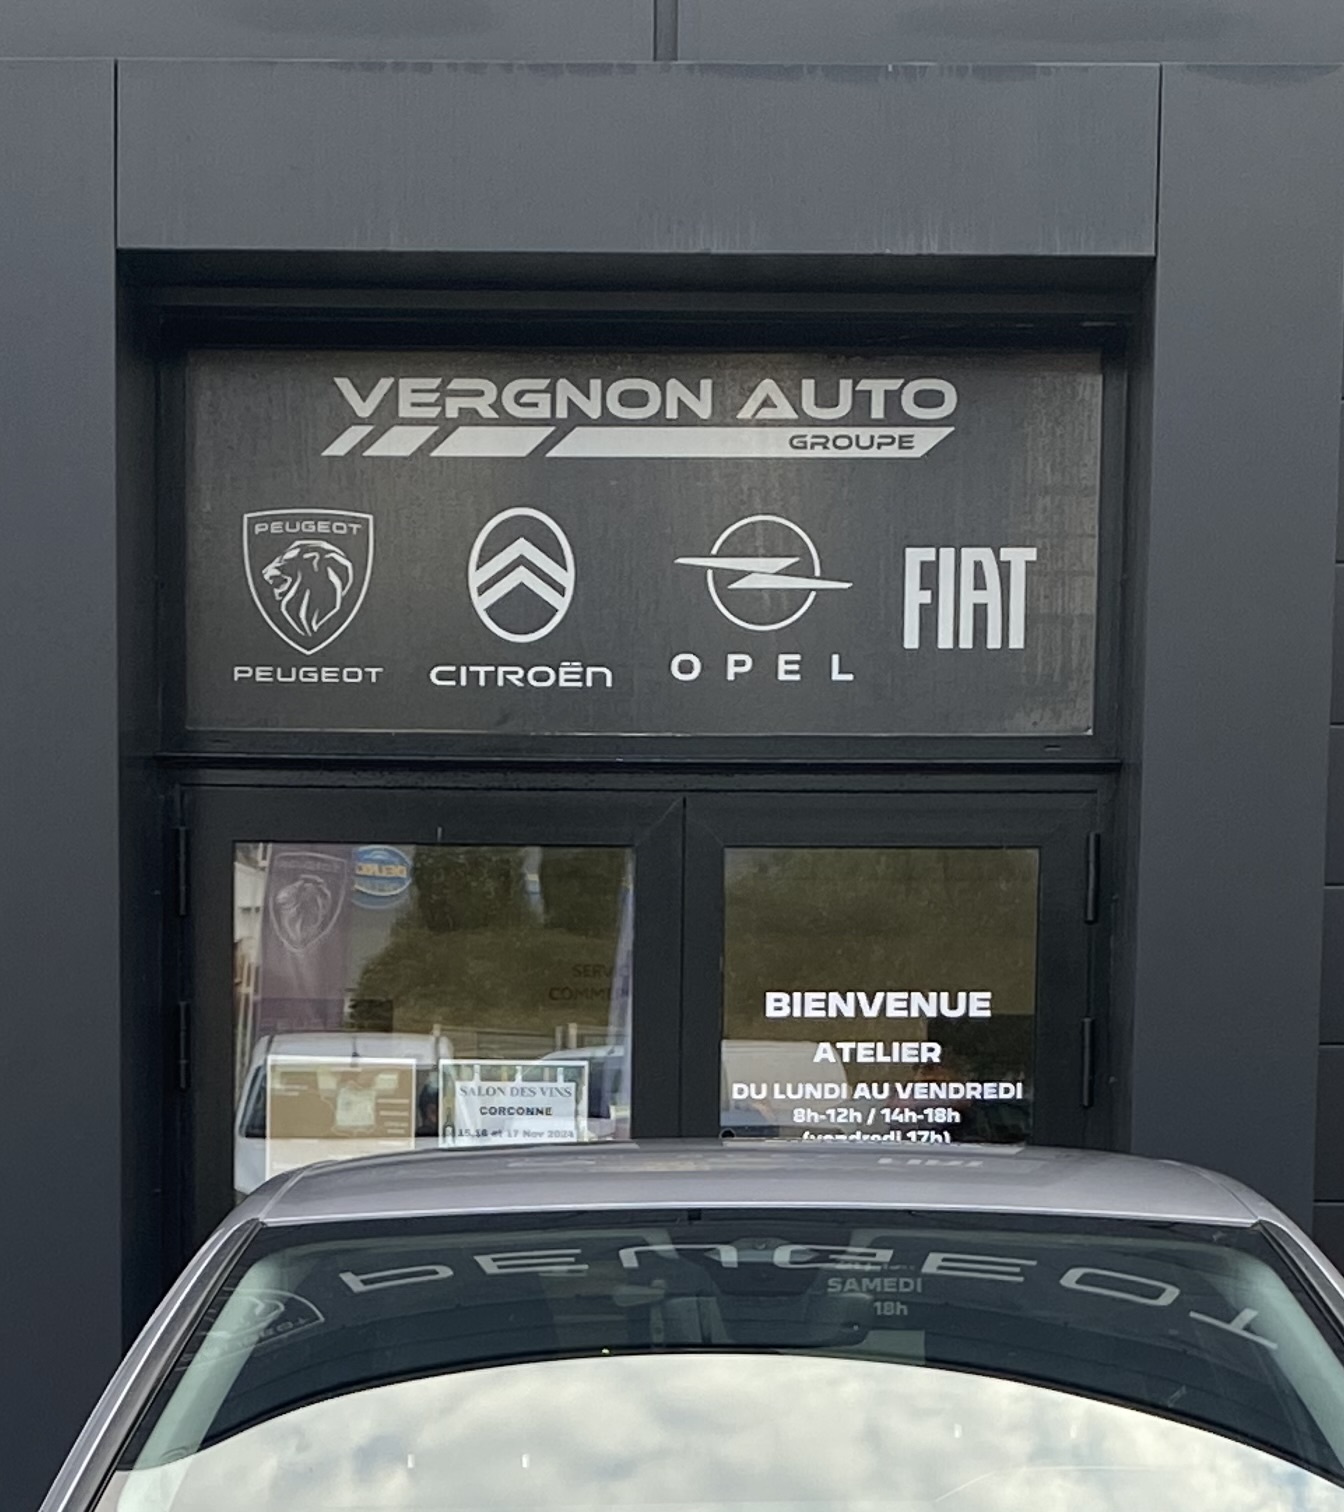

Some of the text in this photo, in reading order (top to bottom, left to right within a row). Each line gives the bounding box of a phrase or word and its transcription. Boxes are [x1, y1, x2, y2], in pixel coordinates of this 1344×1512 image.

[334, 377, 958, 420] VERGNON AUTO
[789, 434, 915, 450] GROUPE
[254, 520, 362, 535] PEUGEOT
[903, 547, 1037, 649] FIAT
[233, 666, 383, 683] PEUGEOT
[429, 661, 612, 687] CITROËN
[670, 653, 853, 681] OPEL
[765, 991, 992, 1018] BIENVENUE
[813, 1041, 942, 1063] ATELIER
[460, 1086, 572, 1098] SALON DES VINS
[732, 1082, 1023, 1100] DU LUNDI AU VENDREDI
[479, 1106, 553, 1116] CORCONNE
[792, 1107, 961, 1126] 8h-12h / 14h-18h
[827, 1276, 923, 1293] SAMEDI
[873, 1301, 909, 1316] 18h
